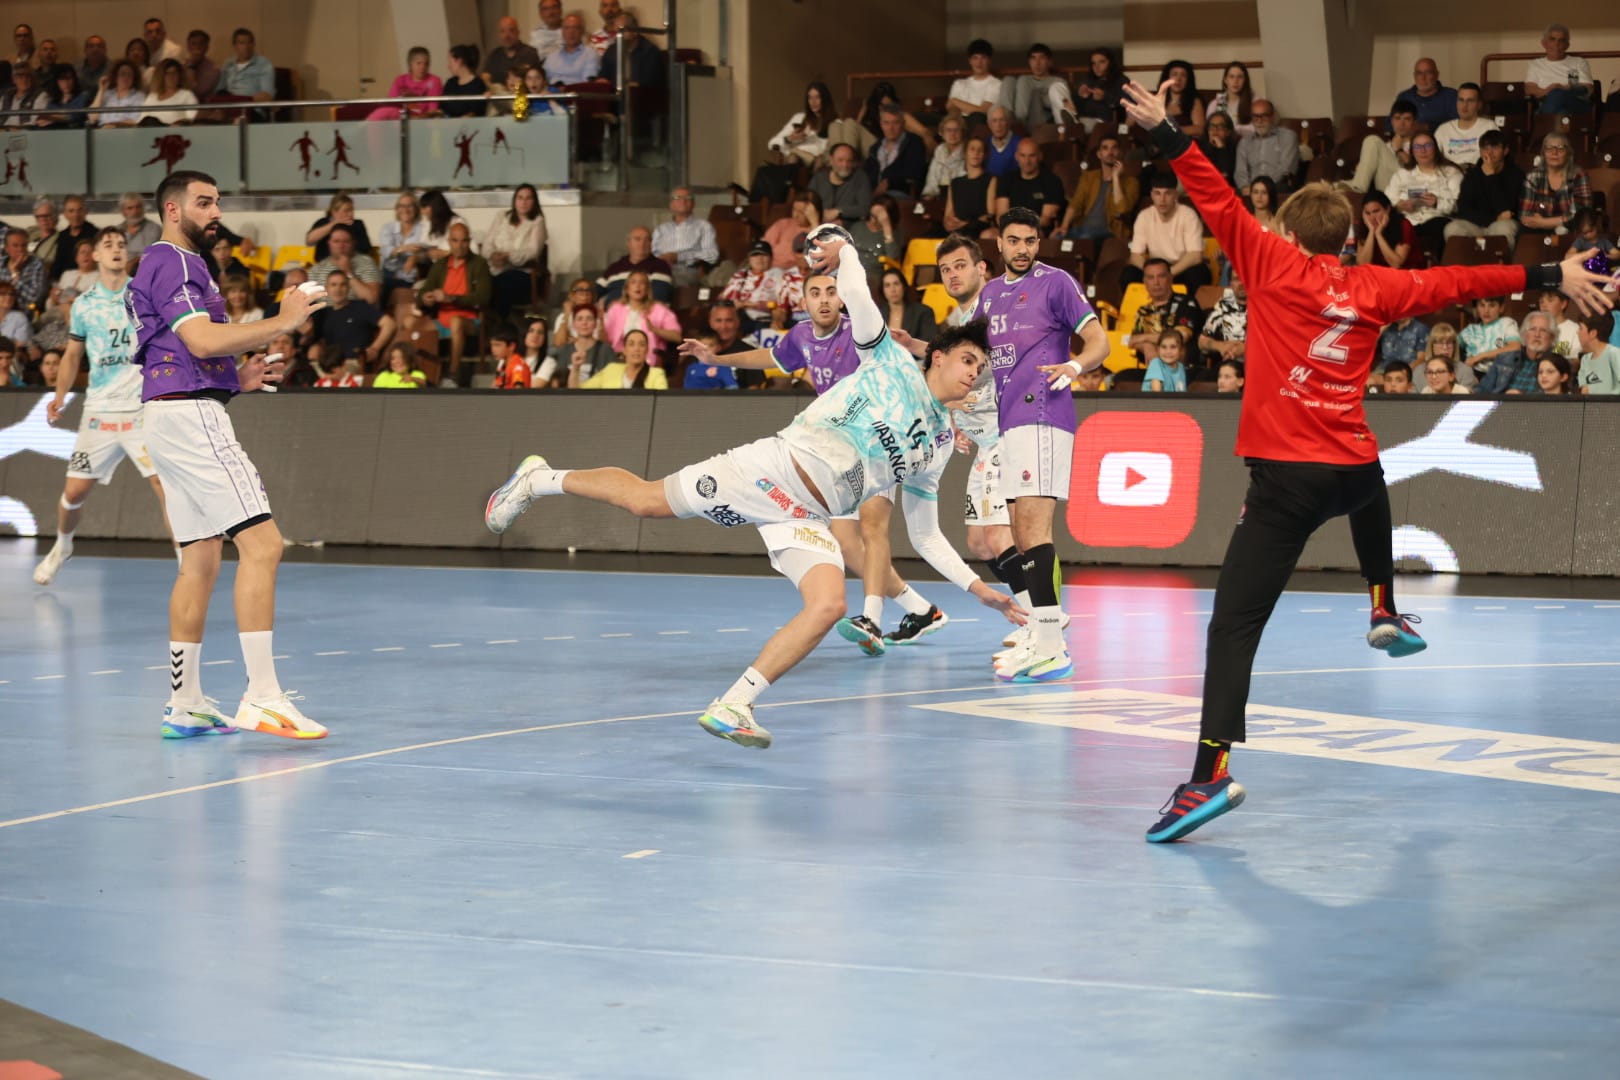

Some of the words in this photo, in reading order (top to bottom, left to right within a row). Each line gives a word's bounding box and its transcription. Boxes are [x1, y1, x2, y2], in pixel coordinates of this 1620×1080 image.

[991, 314, 1007, 335] 55
[1308, 303, 1359, 365] 2
[110, 328, 131, 348] 24
[814, 367, 833, 385] 39
[906, 418, 927, 450] 14
